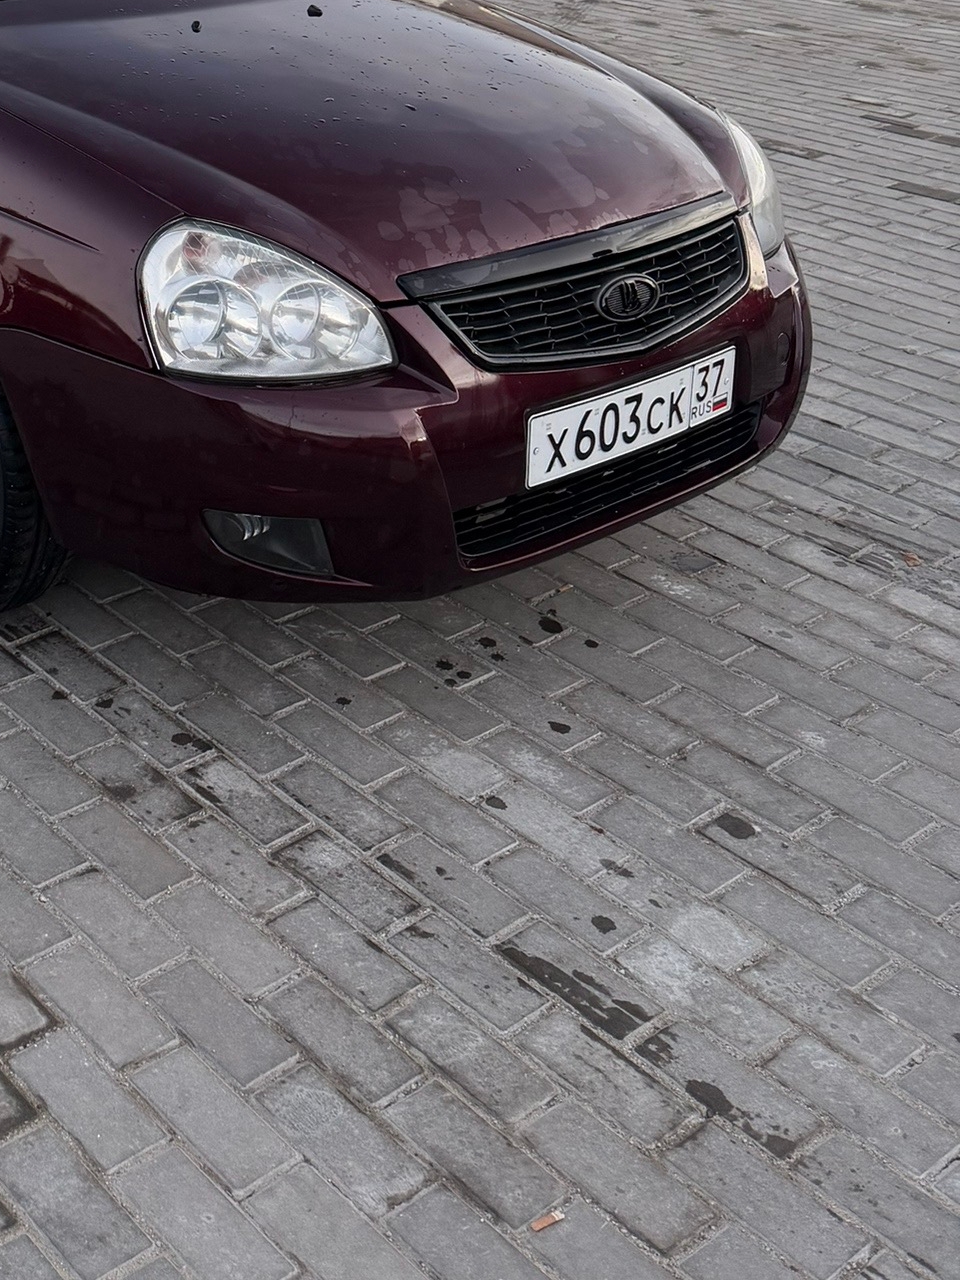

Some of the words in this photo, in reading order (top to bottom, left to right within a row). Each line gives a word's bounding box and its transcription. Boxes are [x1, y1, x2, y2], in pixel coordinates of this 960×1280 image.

[545, 385, 687, 473] Х603СК
[696, 358, 725, 403] 37
[691, 400, 712, 420] RUS
